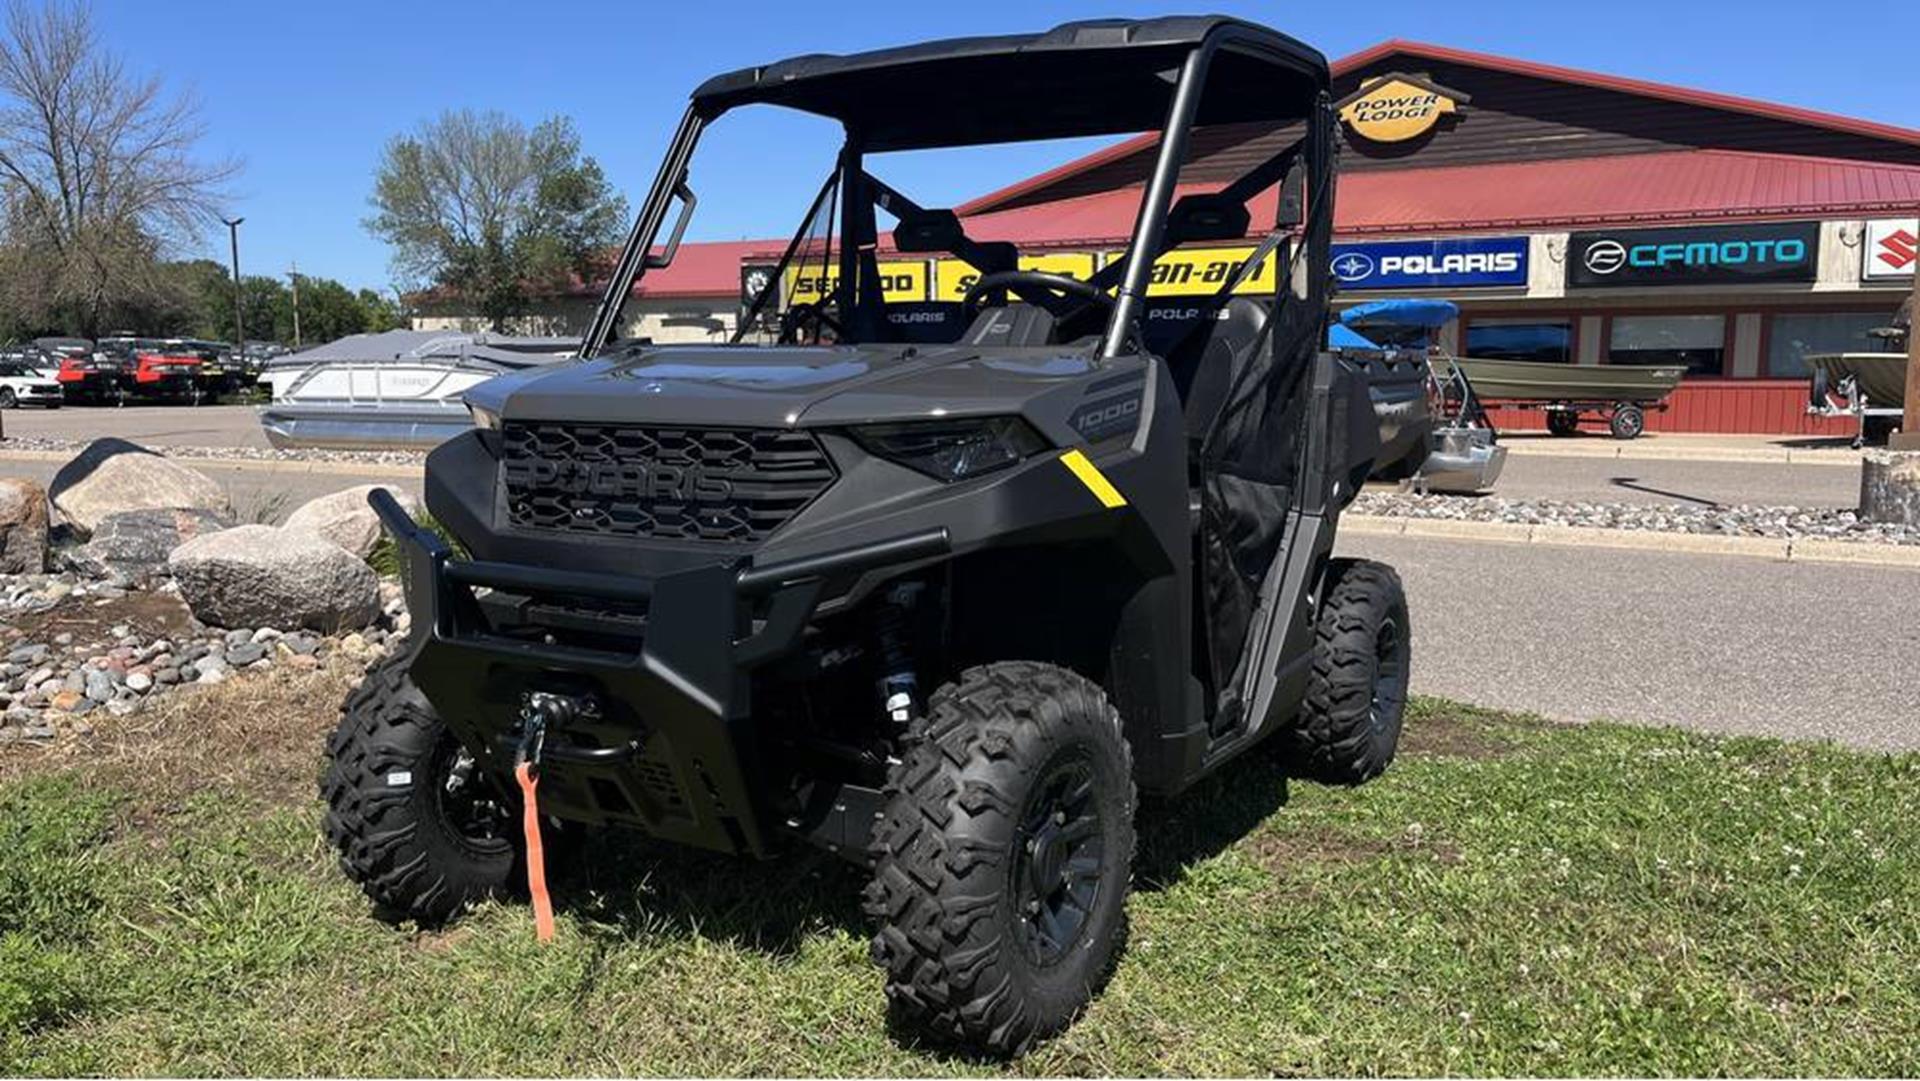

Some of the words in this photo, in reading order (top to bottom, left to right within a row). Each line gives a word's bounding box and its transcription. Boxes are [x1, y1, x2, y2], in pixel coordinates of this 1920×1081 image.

[1353, 95, 1438, 113] POWER
[1380, 252, 1518, 275] POLARIS
[1629, 239, 1805, 267] CFMOTO
[1078, 399, 1139, 431] 1000
[529, 458, 733, 501] POLARIS
